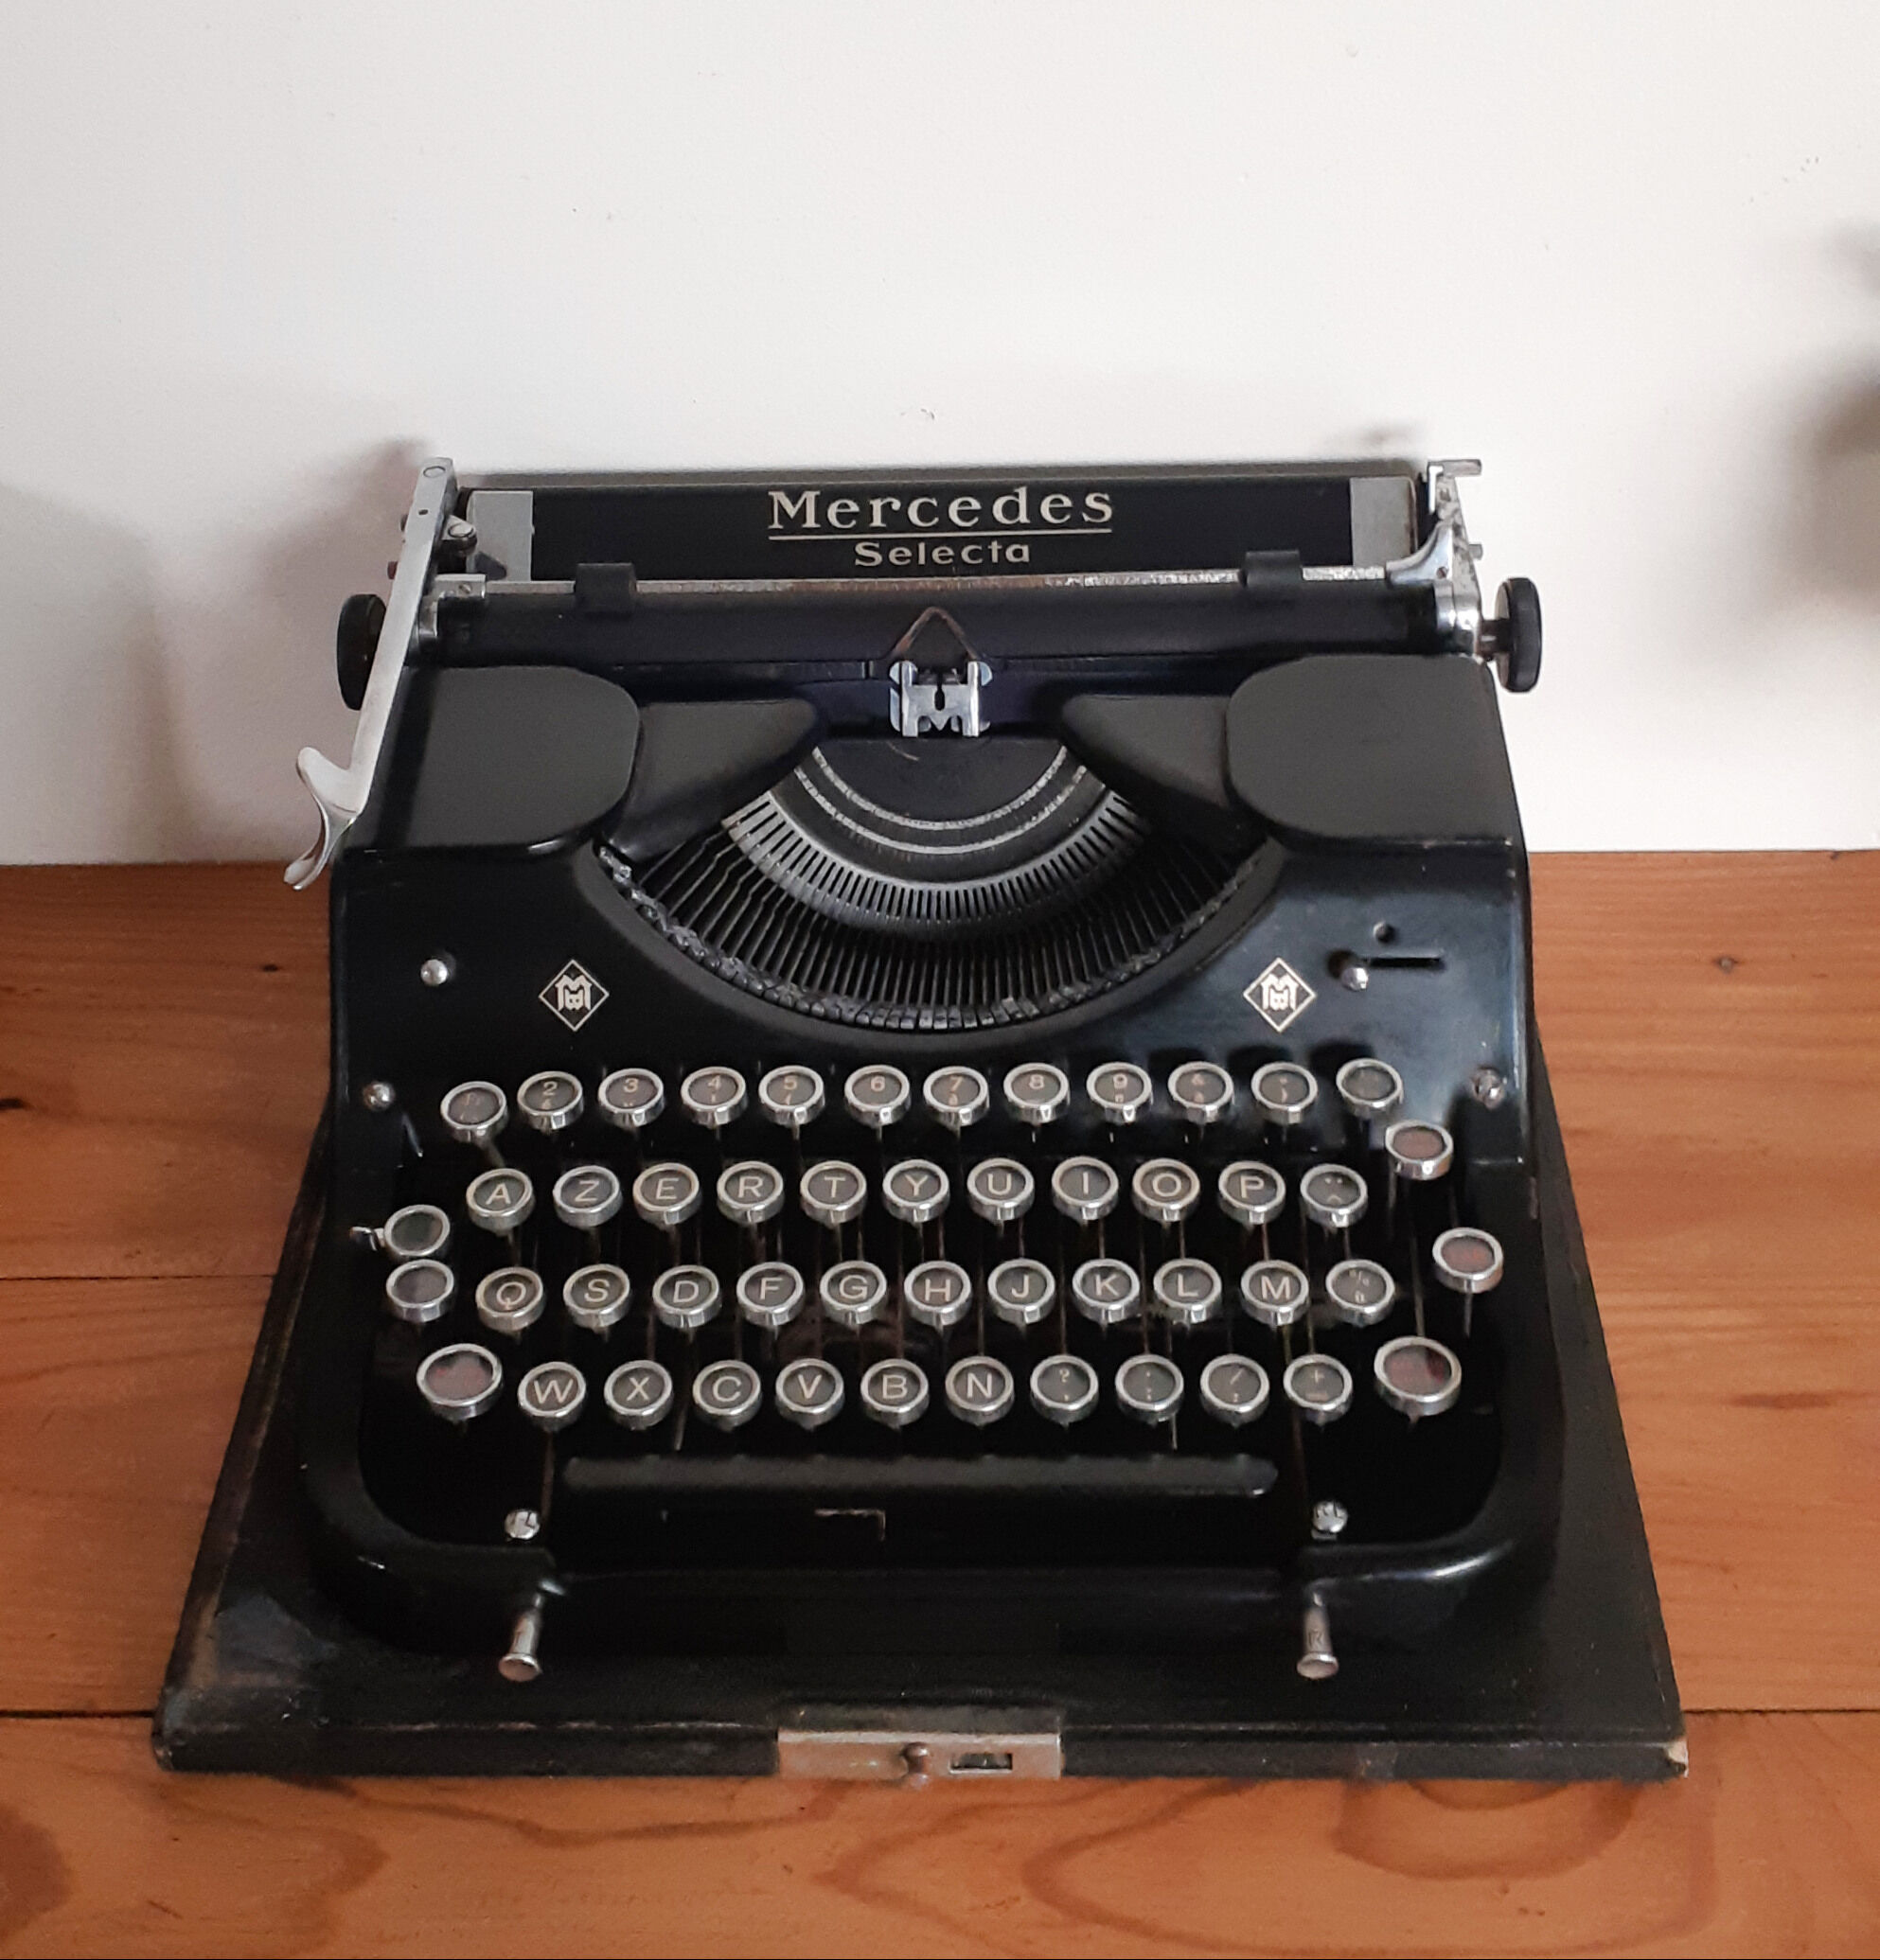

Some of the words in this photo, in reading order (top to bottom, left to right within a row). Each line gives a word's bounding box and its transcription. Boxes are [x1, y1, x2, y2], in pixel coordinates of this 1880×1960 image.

[768, 486, 1113, 530] Mercedes
[854, 540, 1030, 567] Selecta
[542, 1081, 558, 1096] 2
[623, 1078, 639, 1094] 3
[708, 1074, 722, 1090] 4
[784, 1076, 798, 1090] 5
[870, 1076, 886, 1092] 6
[949, 1076, 963, 1092] 7
[1029, 1073, 1045, 1089] 8
[1113, 1074, 1128, 1089] 9
[487, 1183, 513, 1206] A
[576, 1180, 599, 1202] Z
[656, 1178, 678, 1199] E
[738, 1176, 762, 1197] R
[825, 1177, 845, 1197] T
[906, 1175, 928, 1195] Y
[988, 1174, 1011, 1194] U
[1153, 1174, 1181, 1196] O
[1241, 1176, 1264, 1198] P
[497, 1281, 526, 1310] Q
[585, 1280, 609, 1302] S
[674, 1281, 699, 1302] D
[760, 1278, 782, 1299] F
[840, 1276, 867, 1298] G
[924, 1278, 952, 1300] H
[1012, 1276, 1029, 1298] J
[1096, 1275, 1118, 1296] K
[1179, 1275, 1197, 1297] L
[1262, 1277, 1290, 1298] M
[534, 1379, 574, 1404] W
[628, 1378, 648, 1401] X
[714, 1376, 741, 1402] C
[799, 1375, 821, 1399] V
[883, 1375, 907, 1399] B
[967, 1373, 992, 1398] N
